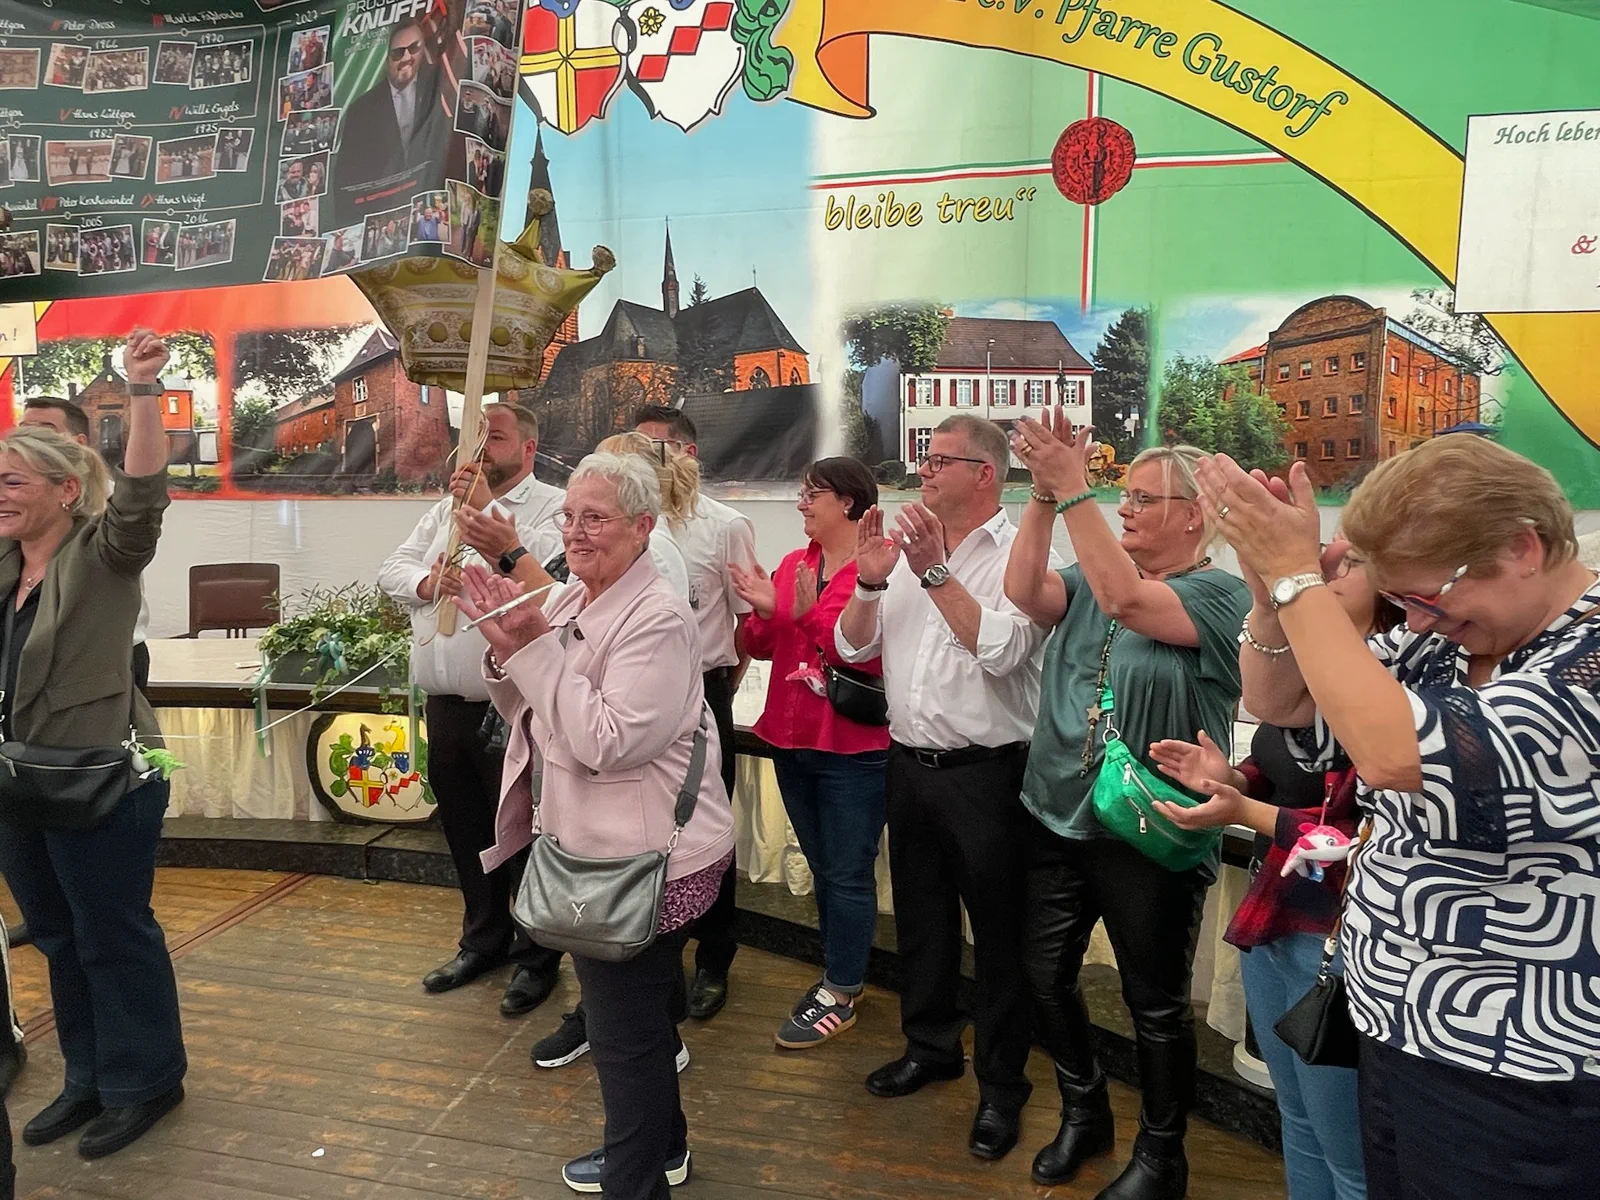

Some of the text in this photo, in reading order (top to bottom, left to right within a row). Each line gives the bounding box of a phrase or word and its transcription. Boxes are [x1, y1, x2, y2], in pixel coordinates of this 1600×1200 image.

[95, 39, 119, 49] 1966
[1055, 0, 1178, 57] Pfarre
[1182, 32, 1349, 138] Gustorf
[72, 108, 98, 119] Hans
[185, 103, 210, 116] Willi
[89, 128, 113, 138] 1982
[1493, 122, 1551, 145] Hoch
[824, 190, 923, 231] bleibe
[81, 216, 104, 228] 2005
[183, 213, 208, 225] 2016
[1571, 235, 1597, 255] &
